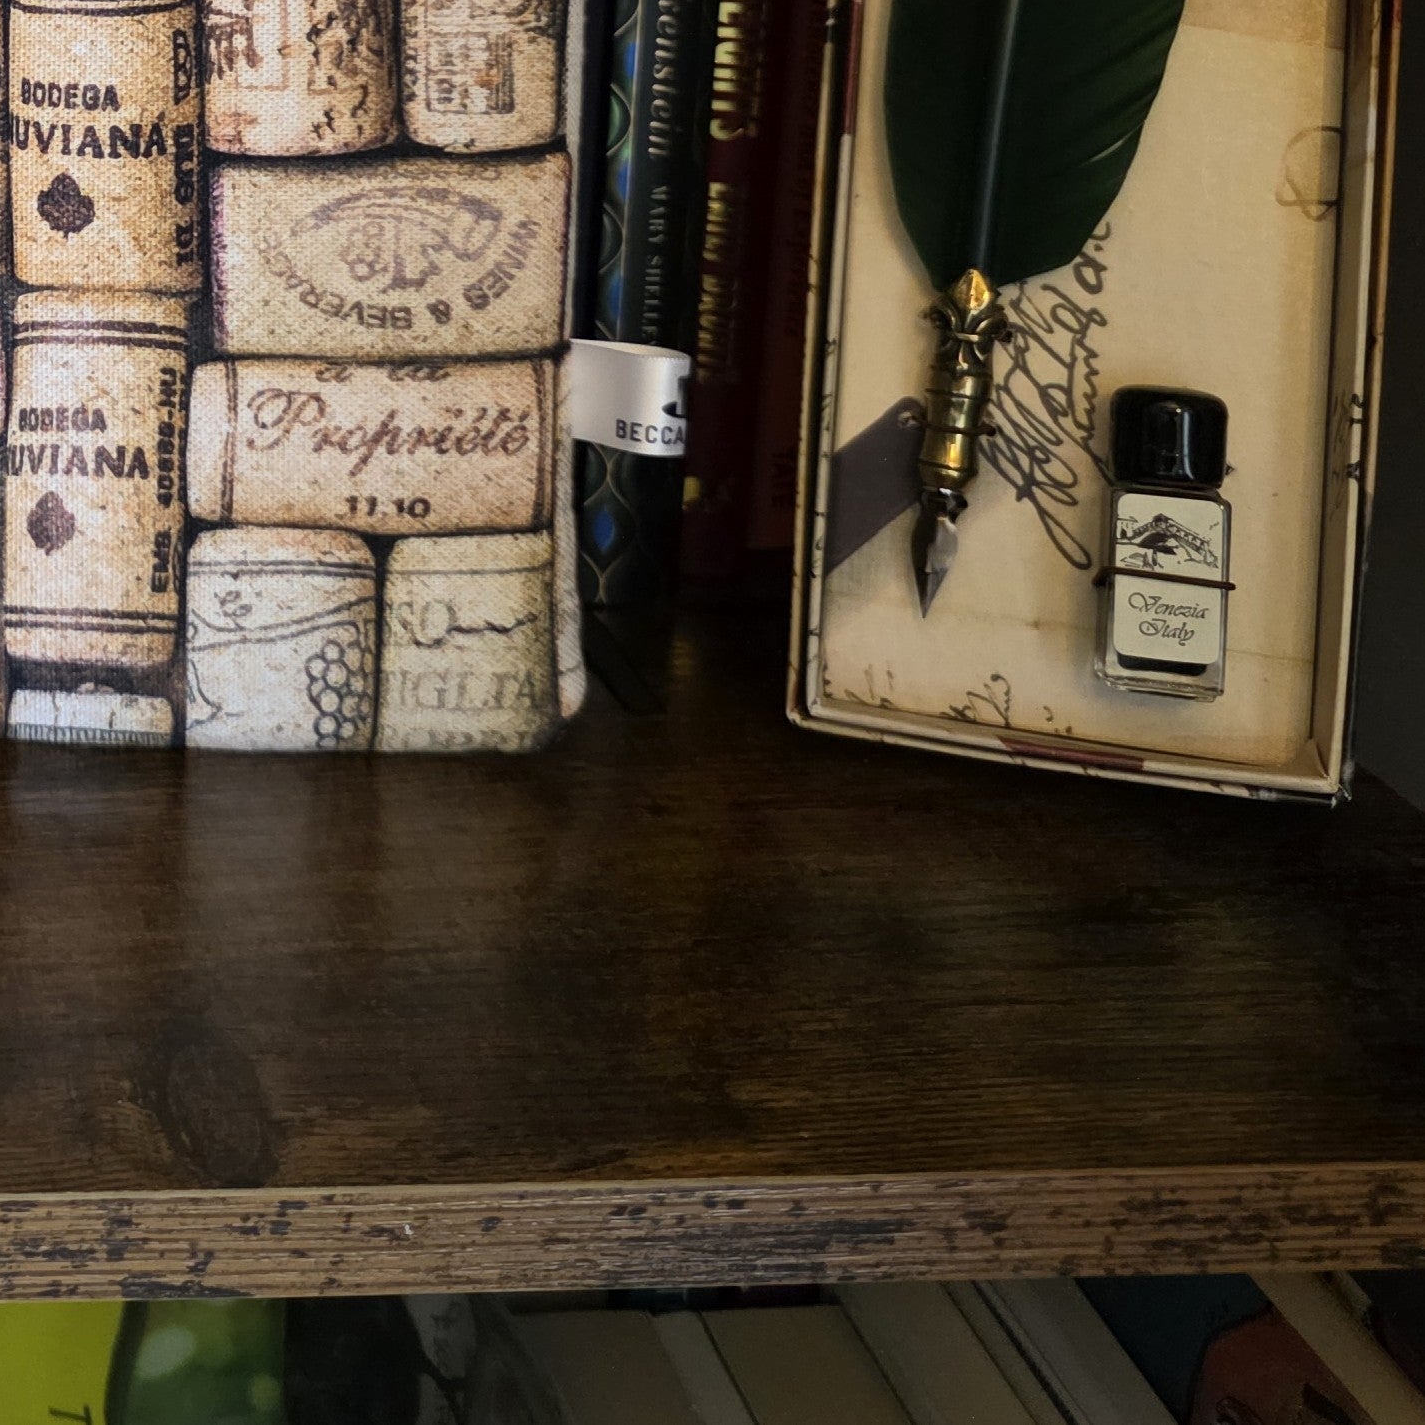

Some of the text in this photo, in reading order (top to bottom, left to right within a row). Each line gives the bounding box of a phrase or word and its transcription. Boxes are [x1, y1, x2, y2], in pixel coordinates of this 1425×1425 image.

[20, 77, 121, 112] BODEGA
[461, 218, 541, 313] WINES
[18, 407, 108, 434] BODEGA
[1127, 590, 1210, 622] Venezia
[1137, 618, 1197, 646] Italy
